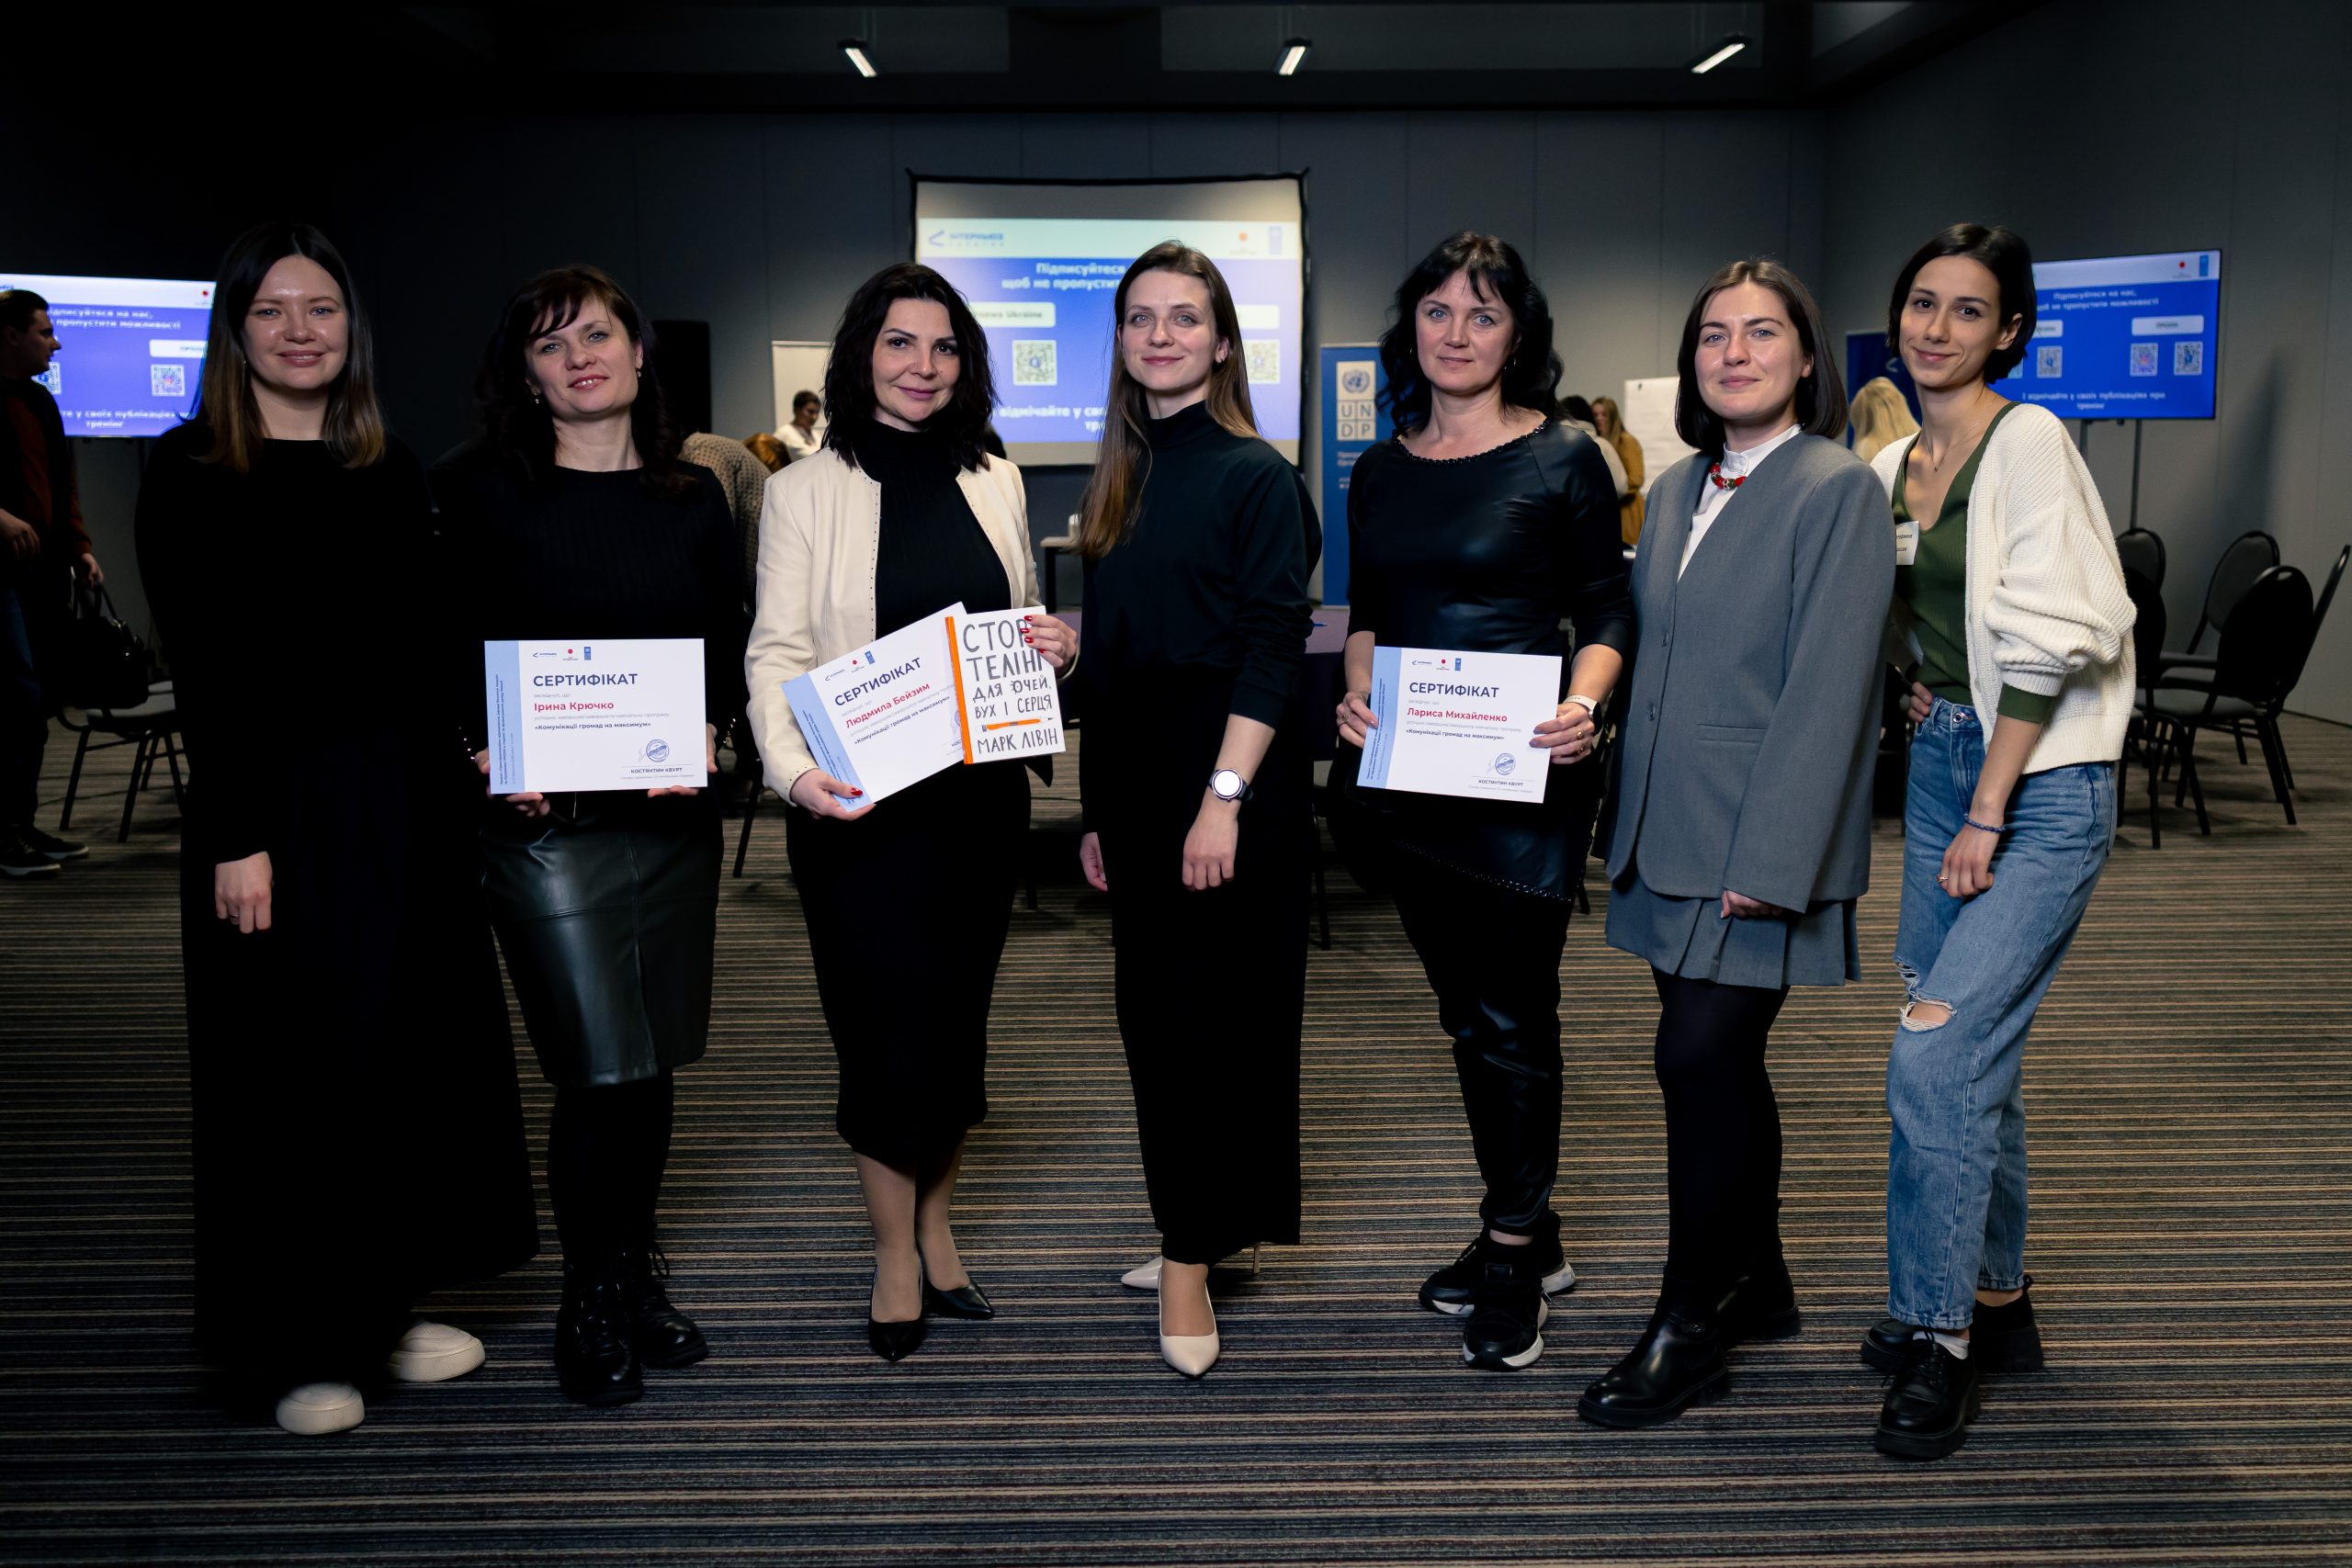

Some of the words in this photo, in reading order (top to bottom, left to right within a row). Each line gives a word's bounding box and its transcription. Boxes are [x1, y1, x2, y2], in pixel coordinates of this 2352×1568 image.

[1036, 263, 1126, 276] Підписуйтеся
[1001, 276, 1031, 290] щоб
[1033, 279, 1051, 288] не
[1053, 278, 1121, 291] пропустит
[963, 618, 1029, 652] СТОР
[533, 673, 638, 687] СЕРТИФІКАТ
[835, 657, 923, 706] СЕРТИФІКАТ
[972, 682, 1003, 703] ДЛЯ
[1409, 682, 1499, 698] СЕРТИФІКАТ
[534, 703, 566, 713] Ірина
[570, 701, 615, 712] Крючко
[846, 701, 892, 728] Людмила
[892, 682, 931, 705] Бейзим
[974, 705, 997, 719] ВУХ
[1017, 694, 1053, 714] СЕРЦЯ
[890, 714, 911, 728] громад
[1407, 707, 1443, 718] Лариса
[1445, 710, 1508, 722] Михайленко
[535, 722, 578, 731] «Комунікації
[977, 734, 1017, 754] МАРК
[1022, 728, 1058, 749] ЛІВІН
[1406, 728, 1442, 737] «Комунікації
[1472, 734, 1505, 742] максимум»
